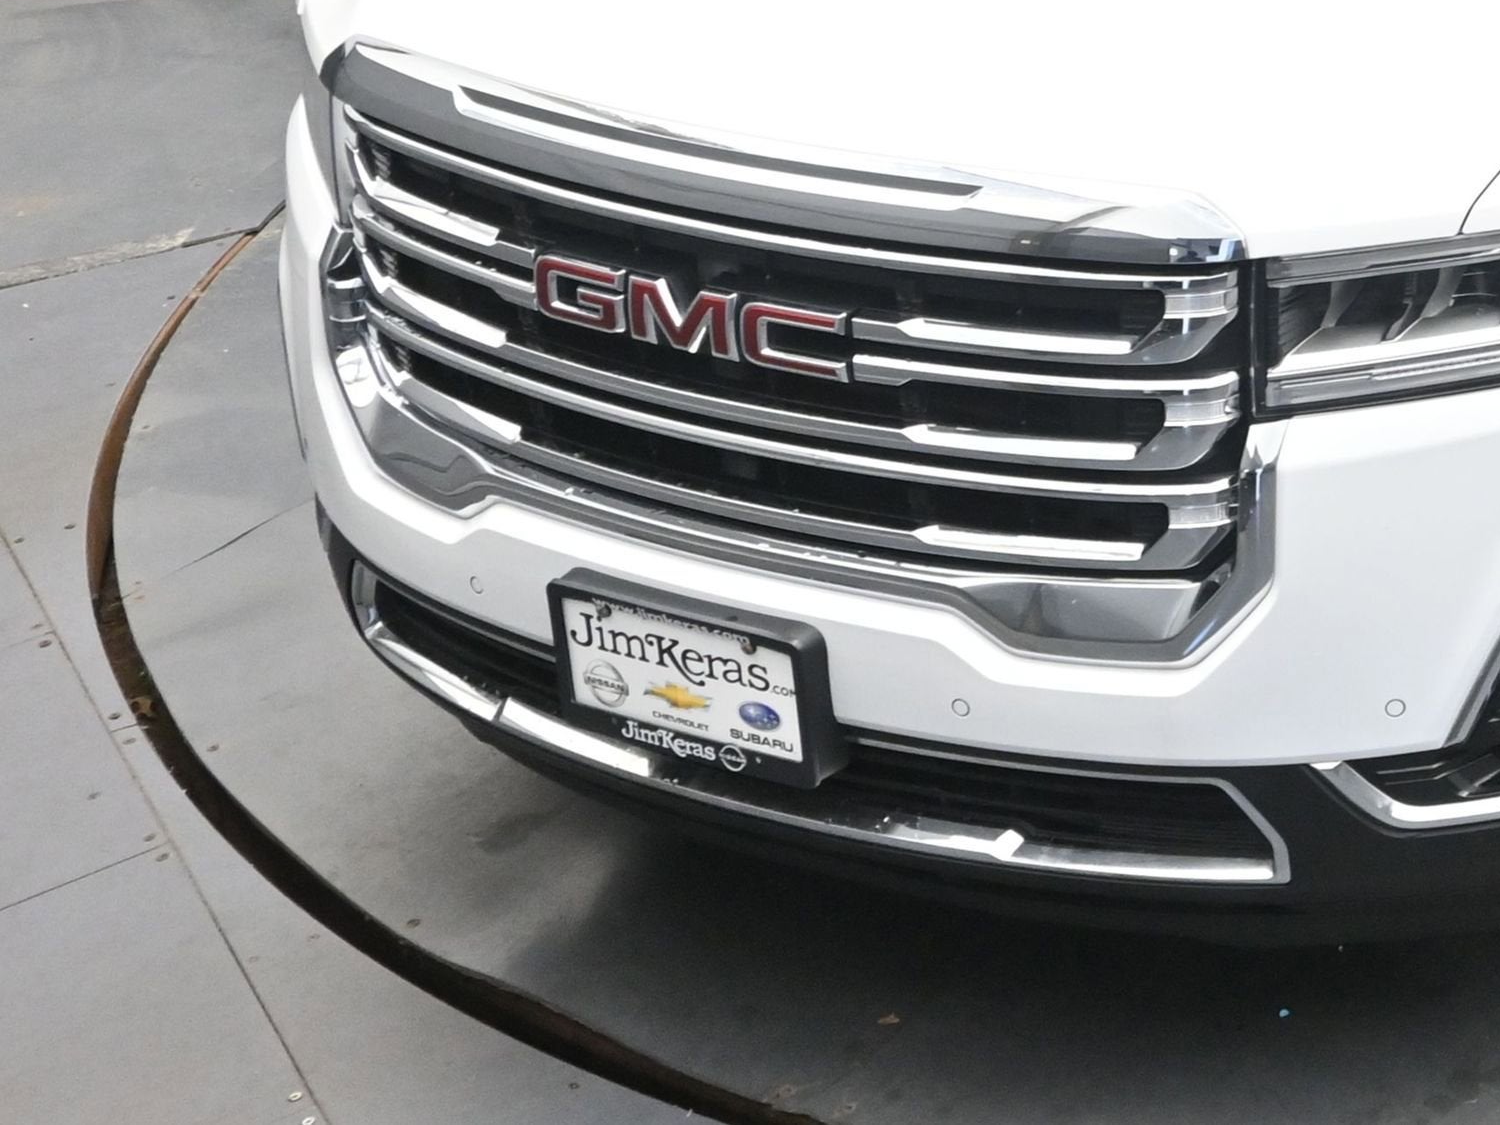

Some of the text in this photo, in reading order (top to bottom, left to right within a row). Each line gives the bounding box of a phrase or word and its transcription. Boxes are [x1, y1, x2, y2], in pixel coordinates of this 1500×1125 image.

[533, 254, 849, 383] GMC
[585, 675, 626, 693] NISSAN
[652, 710, 709, 732] CHEVROLET
[729, 728, 794, 753] SUBARU
